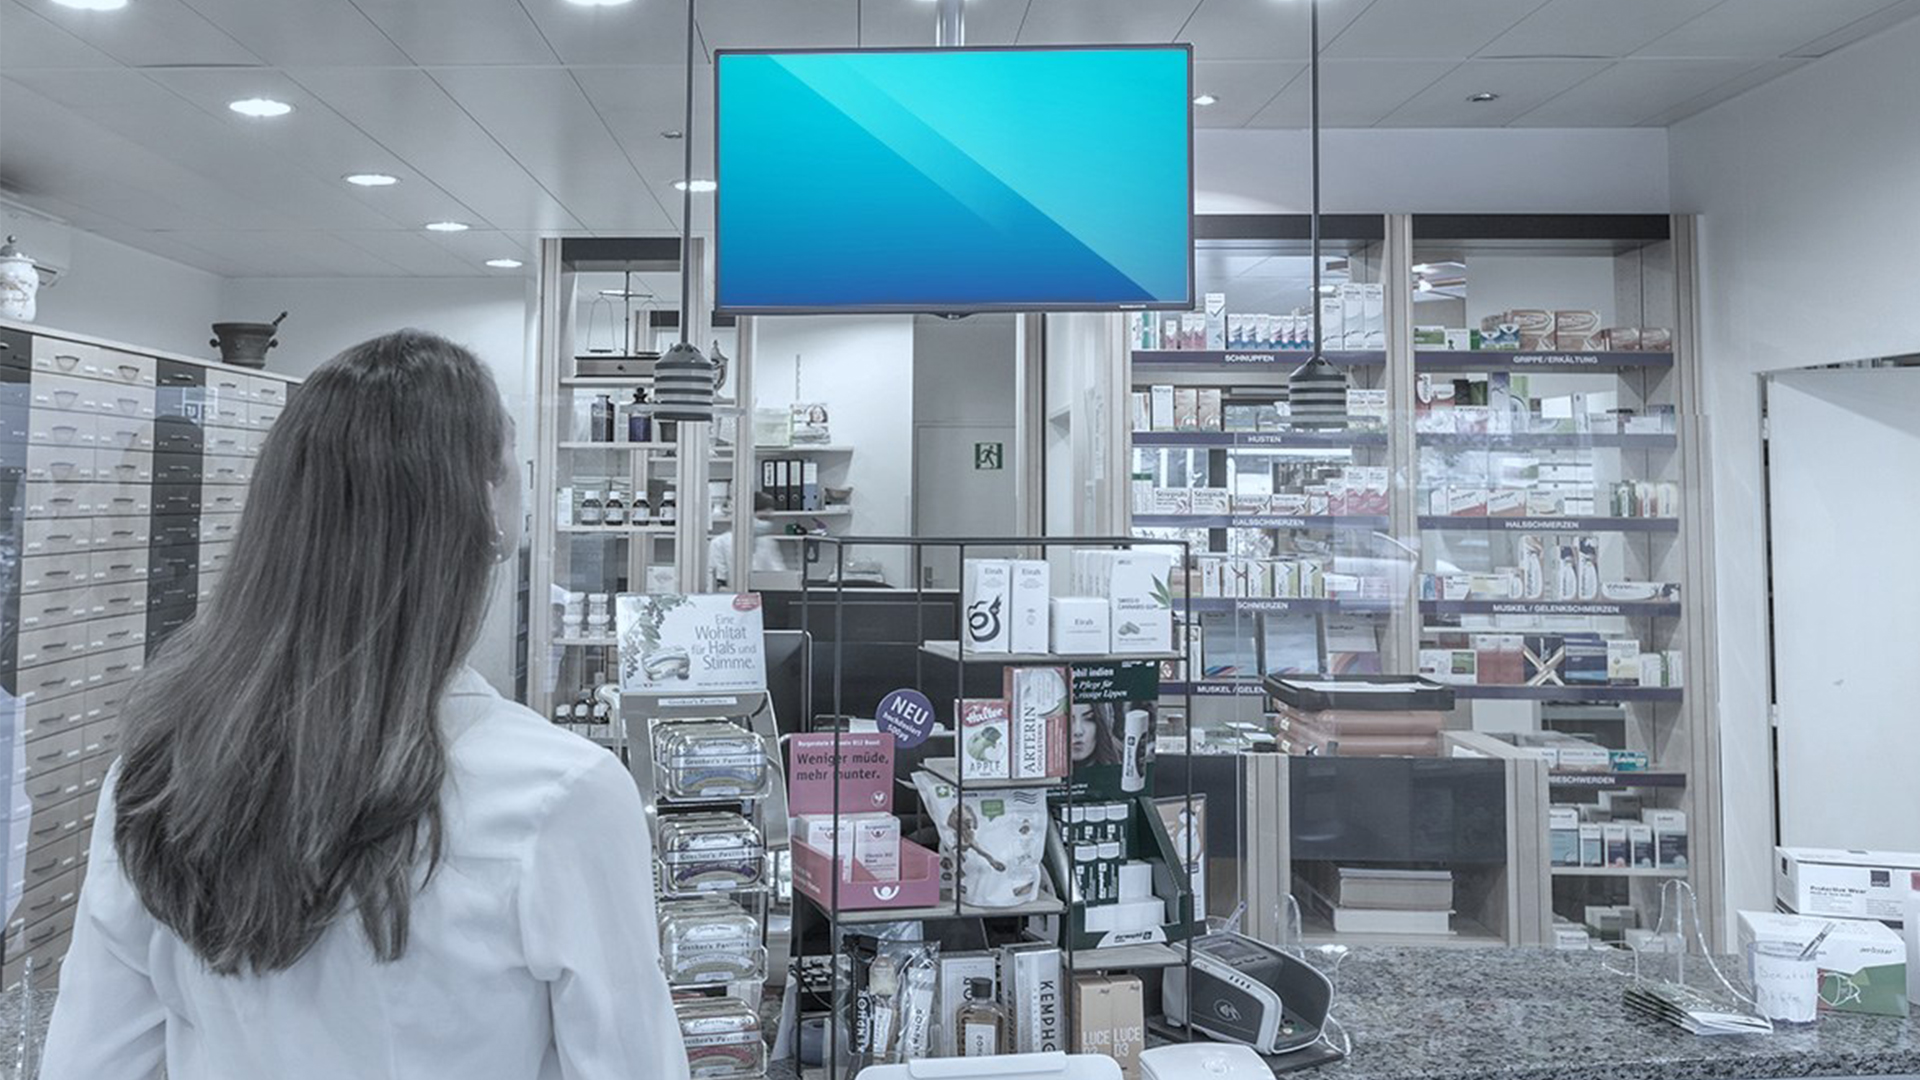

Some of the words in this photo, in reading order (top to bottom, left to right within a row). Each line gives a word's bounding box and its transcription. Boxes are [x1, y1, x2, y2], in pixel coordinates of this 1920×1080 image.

[1224, 354, 1275, 363] SCHNUPFEN
[1512, 354, 1599, 364] GRIPPE/ERKÄLTUNG
[1247, 435, 1283, 444] HUSTEN
[1232, 517, 1306, 527] HALSSCHMERZEN
[1505, 520, 1580, 530] HALSSCHMERZEN
[1236, 601, 1289, 610] SCHMERZEN
[1493, 604, 1528, 613] MUSKEL
[1535, 604, 1620, 614] GELENKSCHMERZEN
[715, 614, 735, 625] Eine
[694, 626, 747, 641] Wohltat
[691, 643, 706, 655] für
[708, 640, 737, 655] Hals
[737, 643, 757, 655] und
[703, 654, 756, 671] Stimme.
[1197, 685, 1231, 694] MUSKEL
[890, 696, 929, 725] NEU
[1023, 706, 1036, 773] ARTERIN
[852, 750, 889, 765] müde,
[969, 761, 1001, 772] APPLE
[796, 769, 828, 781] mehr
[1083, 1030, 1111, 1045] LUCE
[1113, 1026, 1141, 1042] LUCE
[1114, 1043, 1130, 1057] D3
